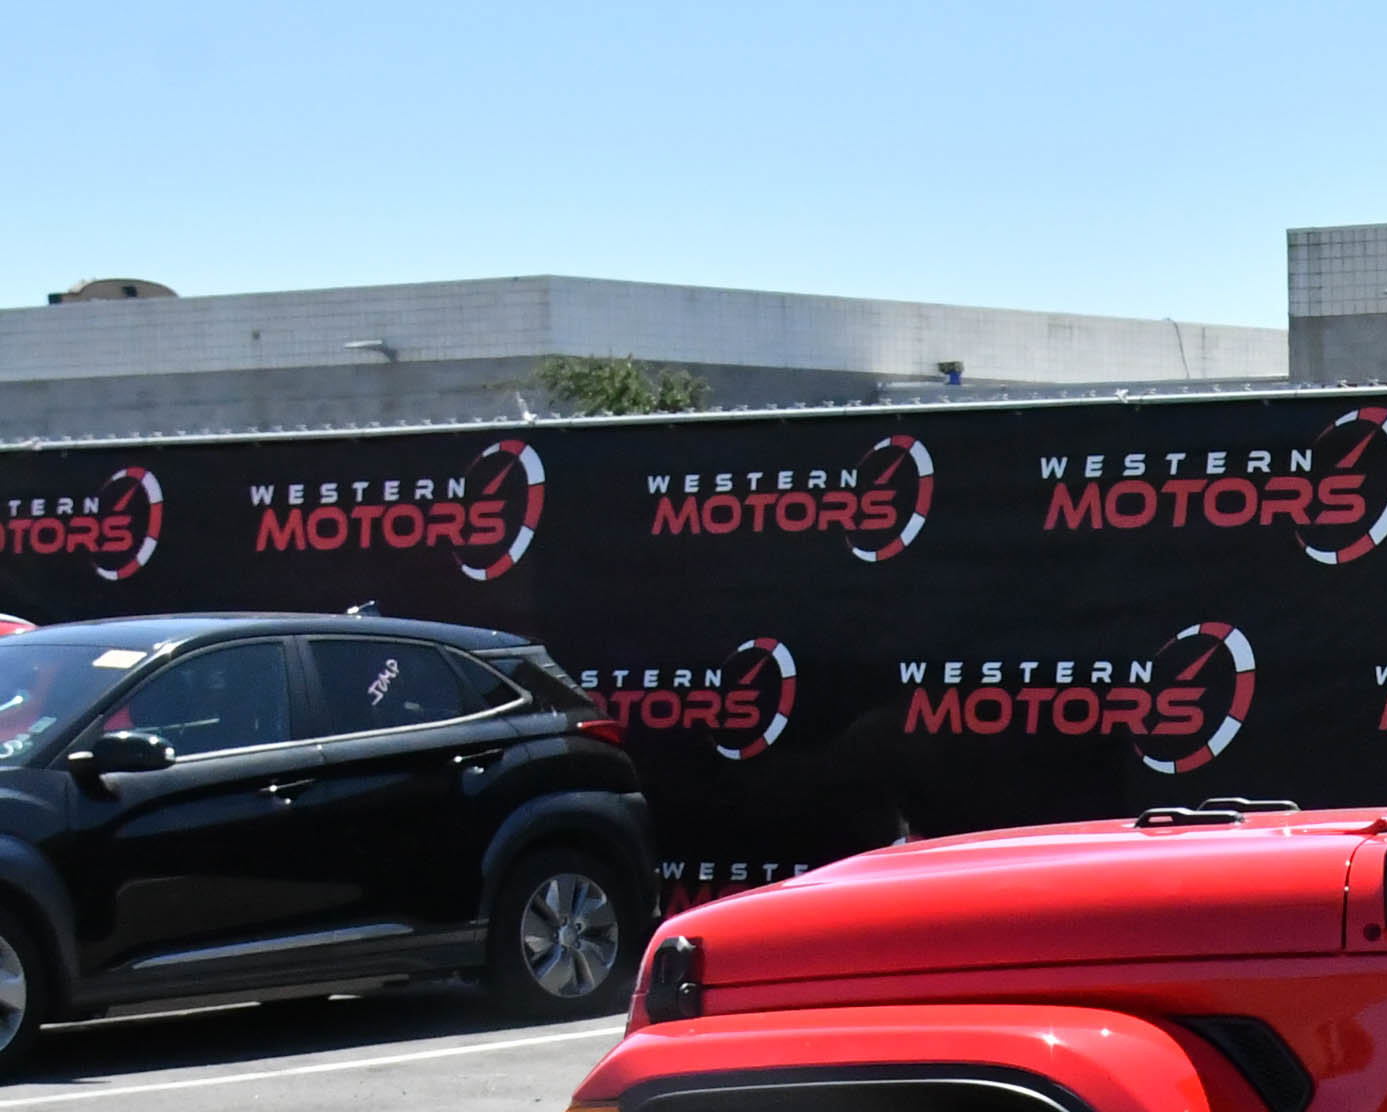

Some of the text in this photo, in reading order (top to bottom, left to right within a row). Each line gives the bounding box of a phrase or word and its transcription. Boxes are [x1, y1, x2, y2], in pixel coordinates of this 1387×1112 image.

[647, 469, 858, 494] WESTERN
[1040, 450, 1312, 479] WESTERN
[251, 477, 466, 506] WESTERN
[1046, 474, 1366, 529] MOTORS
[255, 500, 506, 551] MOTORS
[652, 491, 897, 535] MOTORS
[0, 515, 133, 554] TORS
[900, 661, 1153, 684] WESTERN
[903, 687, 1205, 735] MOTORS
